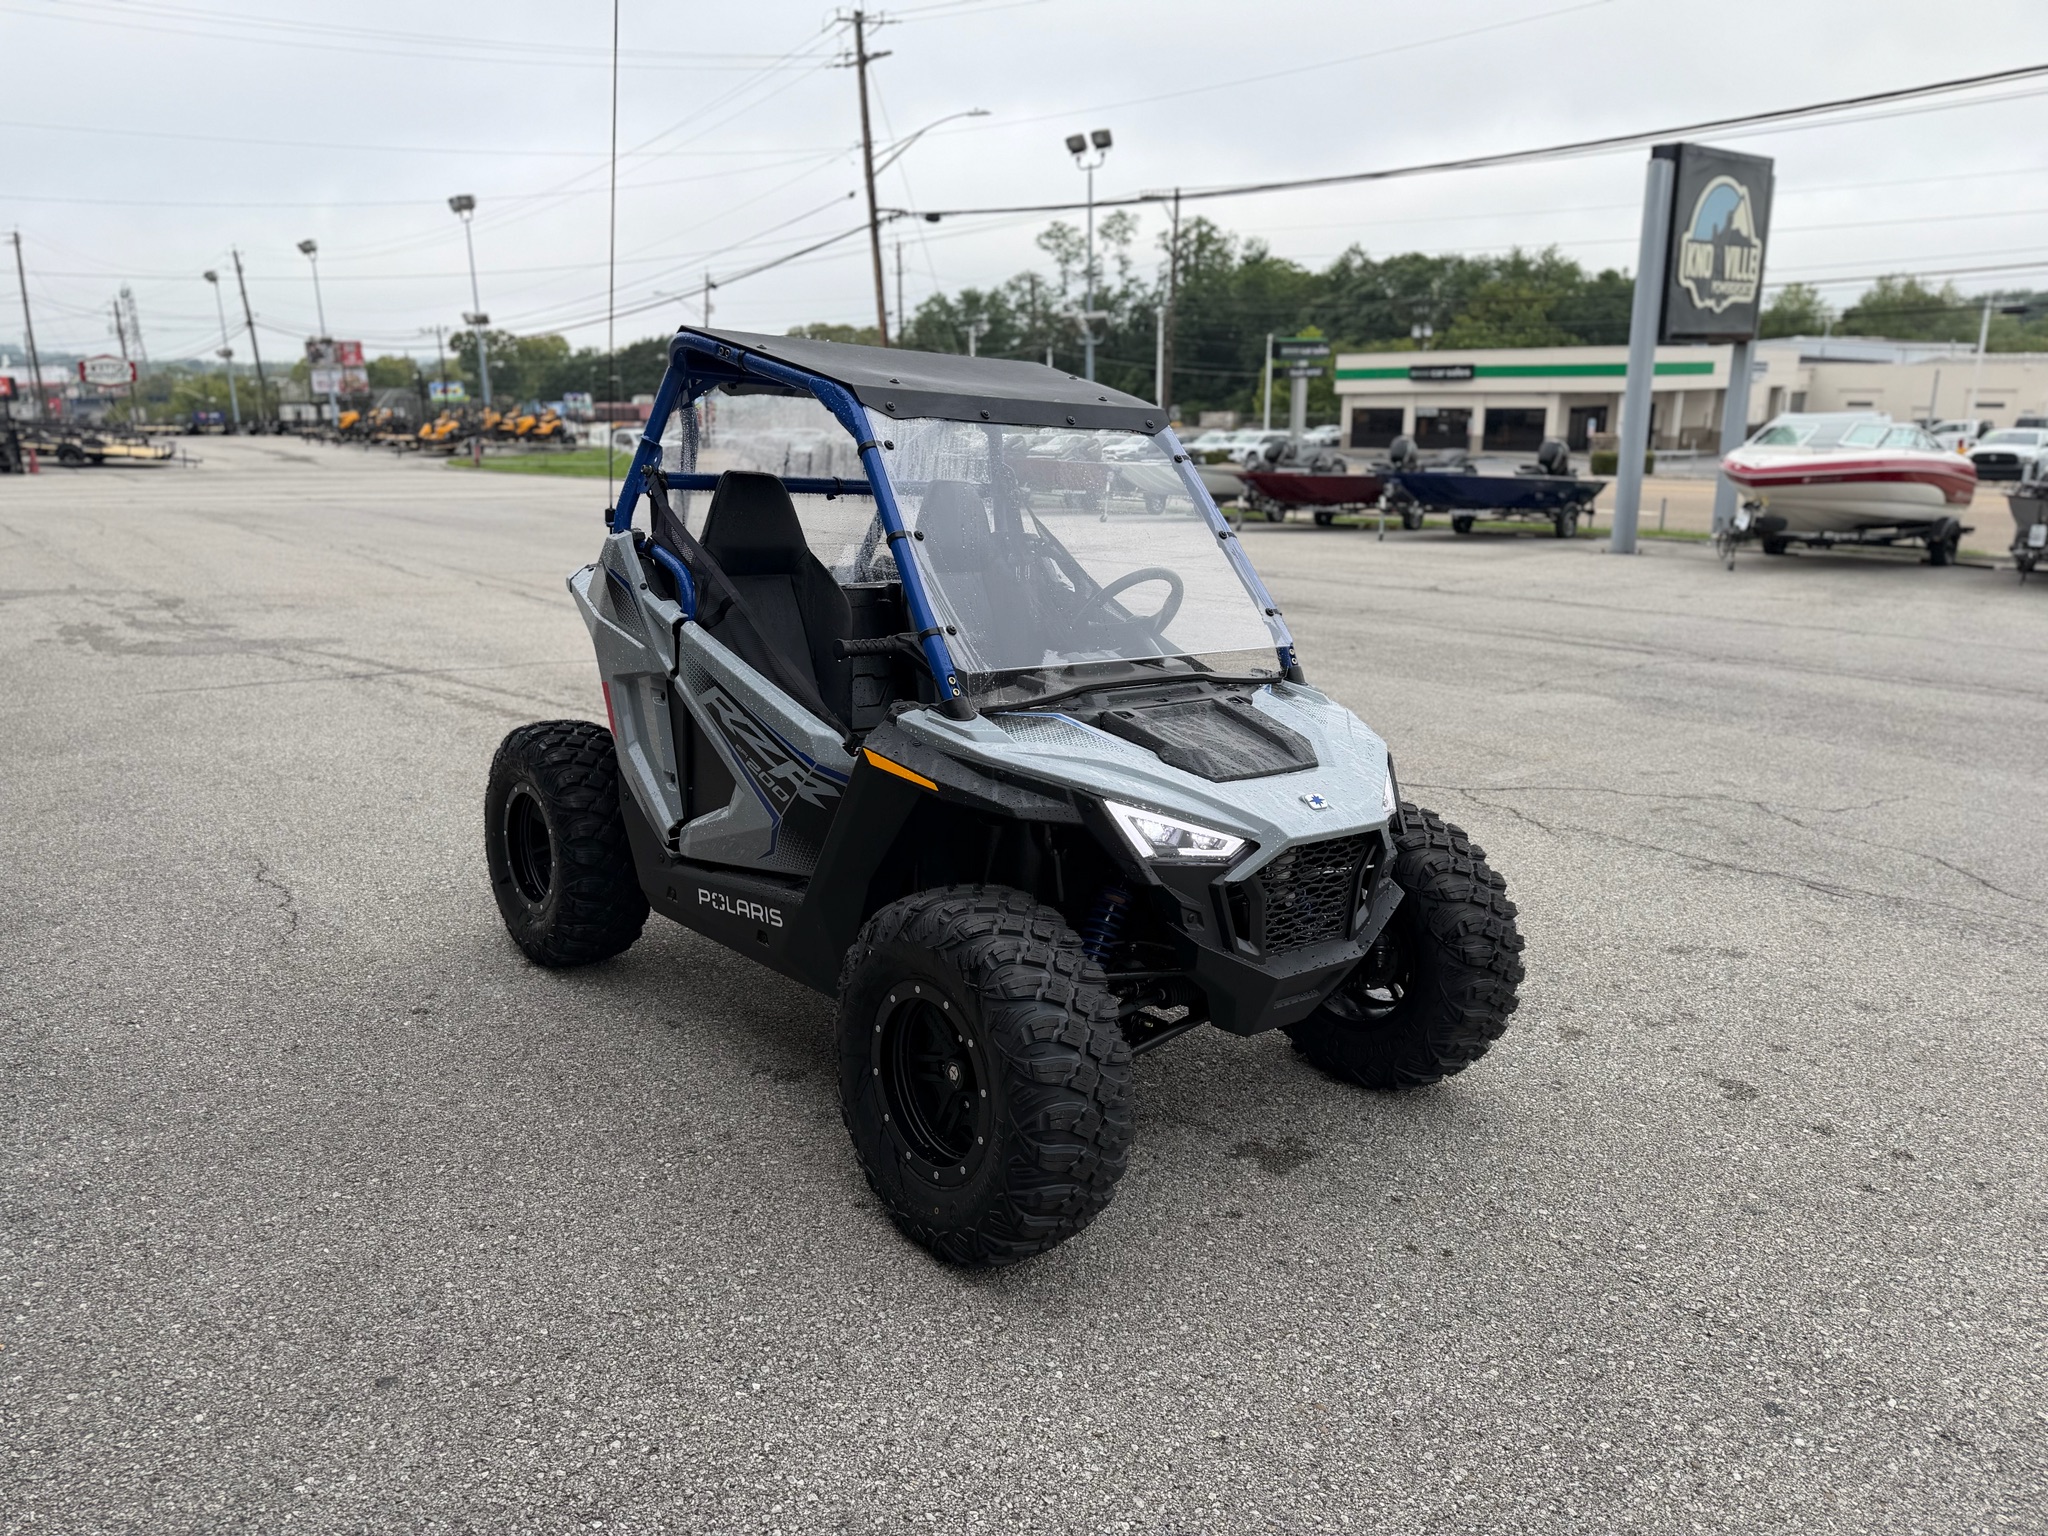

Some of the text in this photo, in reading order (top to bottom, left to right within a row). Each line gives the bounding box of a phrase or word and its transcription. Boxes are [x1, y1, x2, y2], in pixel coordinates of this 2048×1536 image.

[1684, 242, 1757, 281] KNOVILLE
[699, 685, 842, 811] RZR
[746, 757, 790, 802] 200
[698, 888, 783, 928] POLARIS
